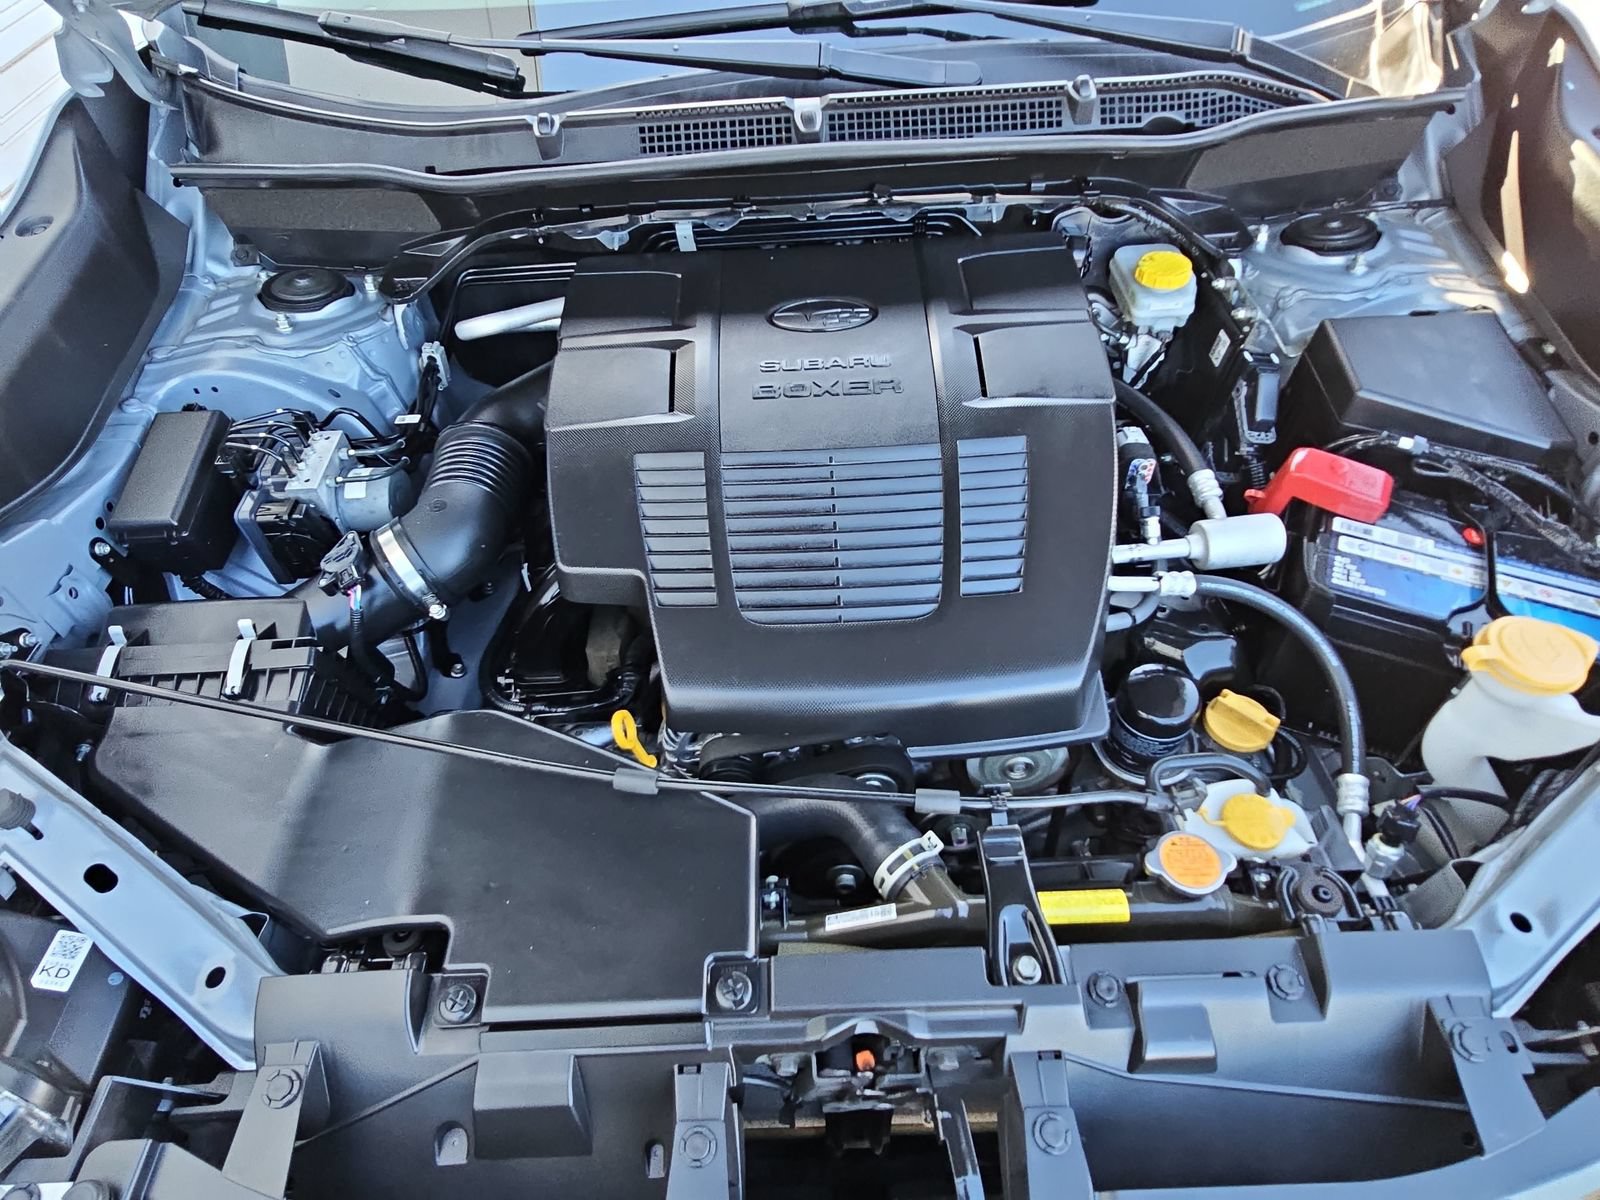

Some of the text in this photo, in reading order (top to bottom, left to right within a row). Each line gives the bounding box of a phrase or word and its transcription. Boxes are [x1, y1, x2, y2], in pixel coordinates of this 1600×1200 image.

[760, 355, 891, 372] SUBARU
[752, 377, 904, 400] BOXER
[39, 965, 70, 979] KD
